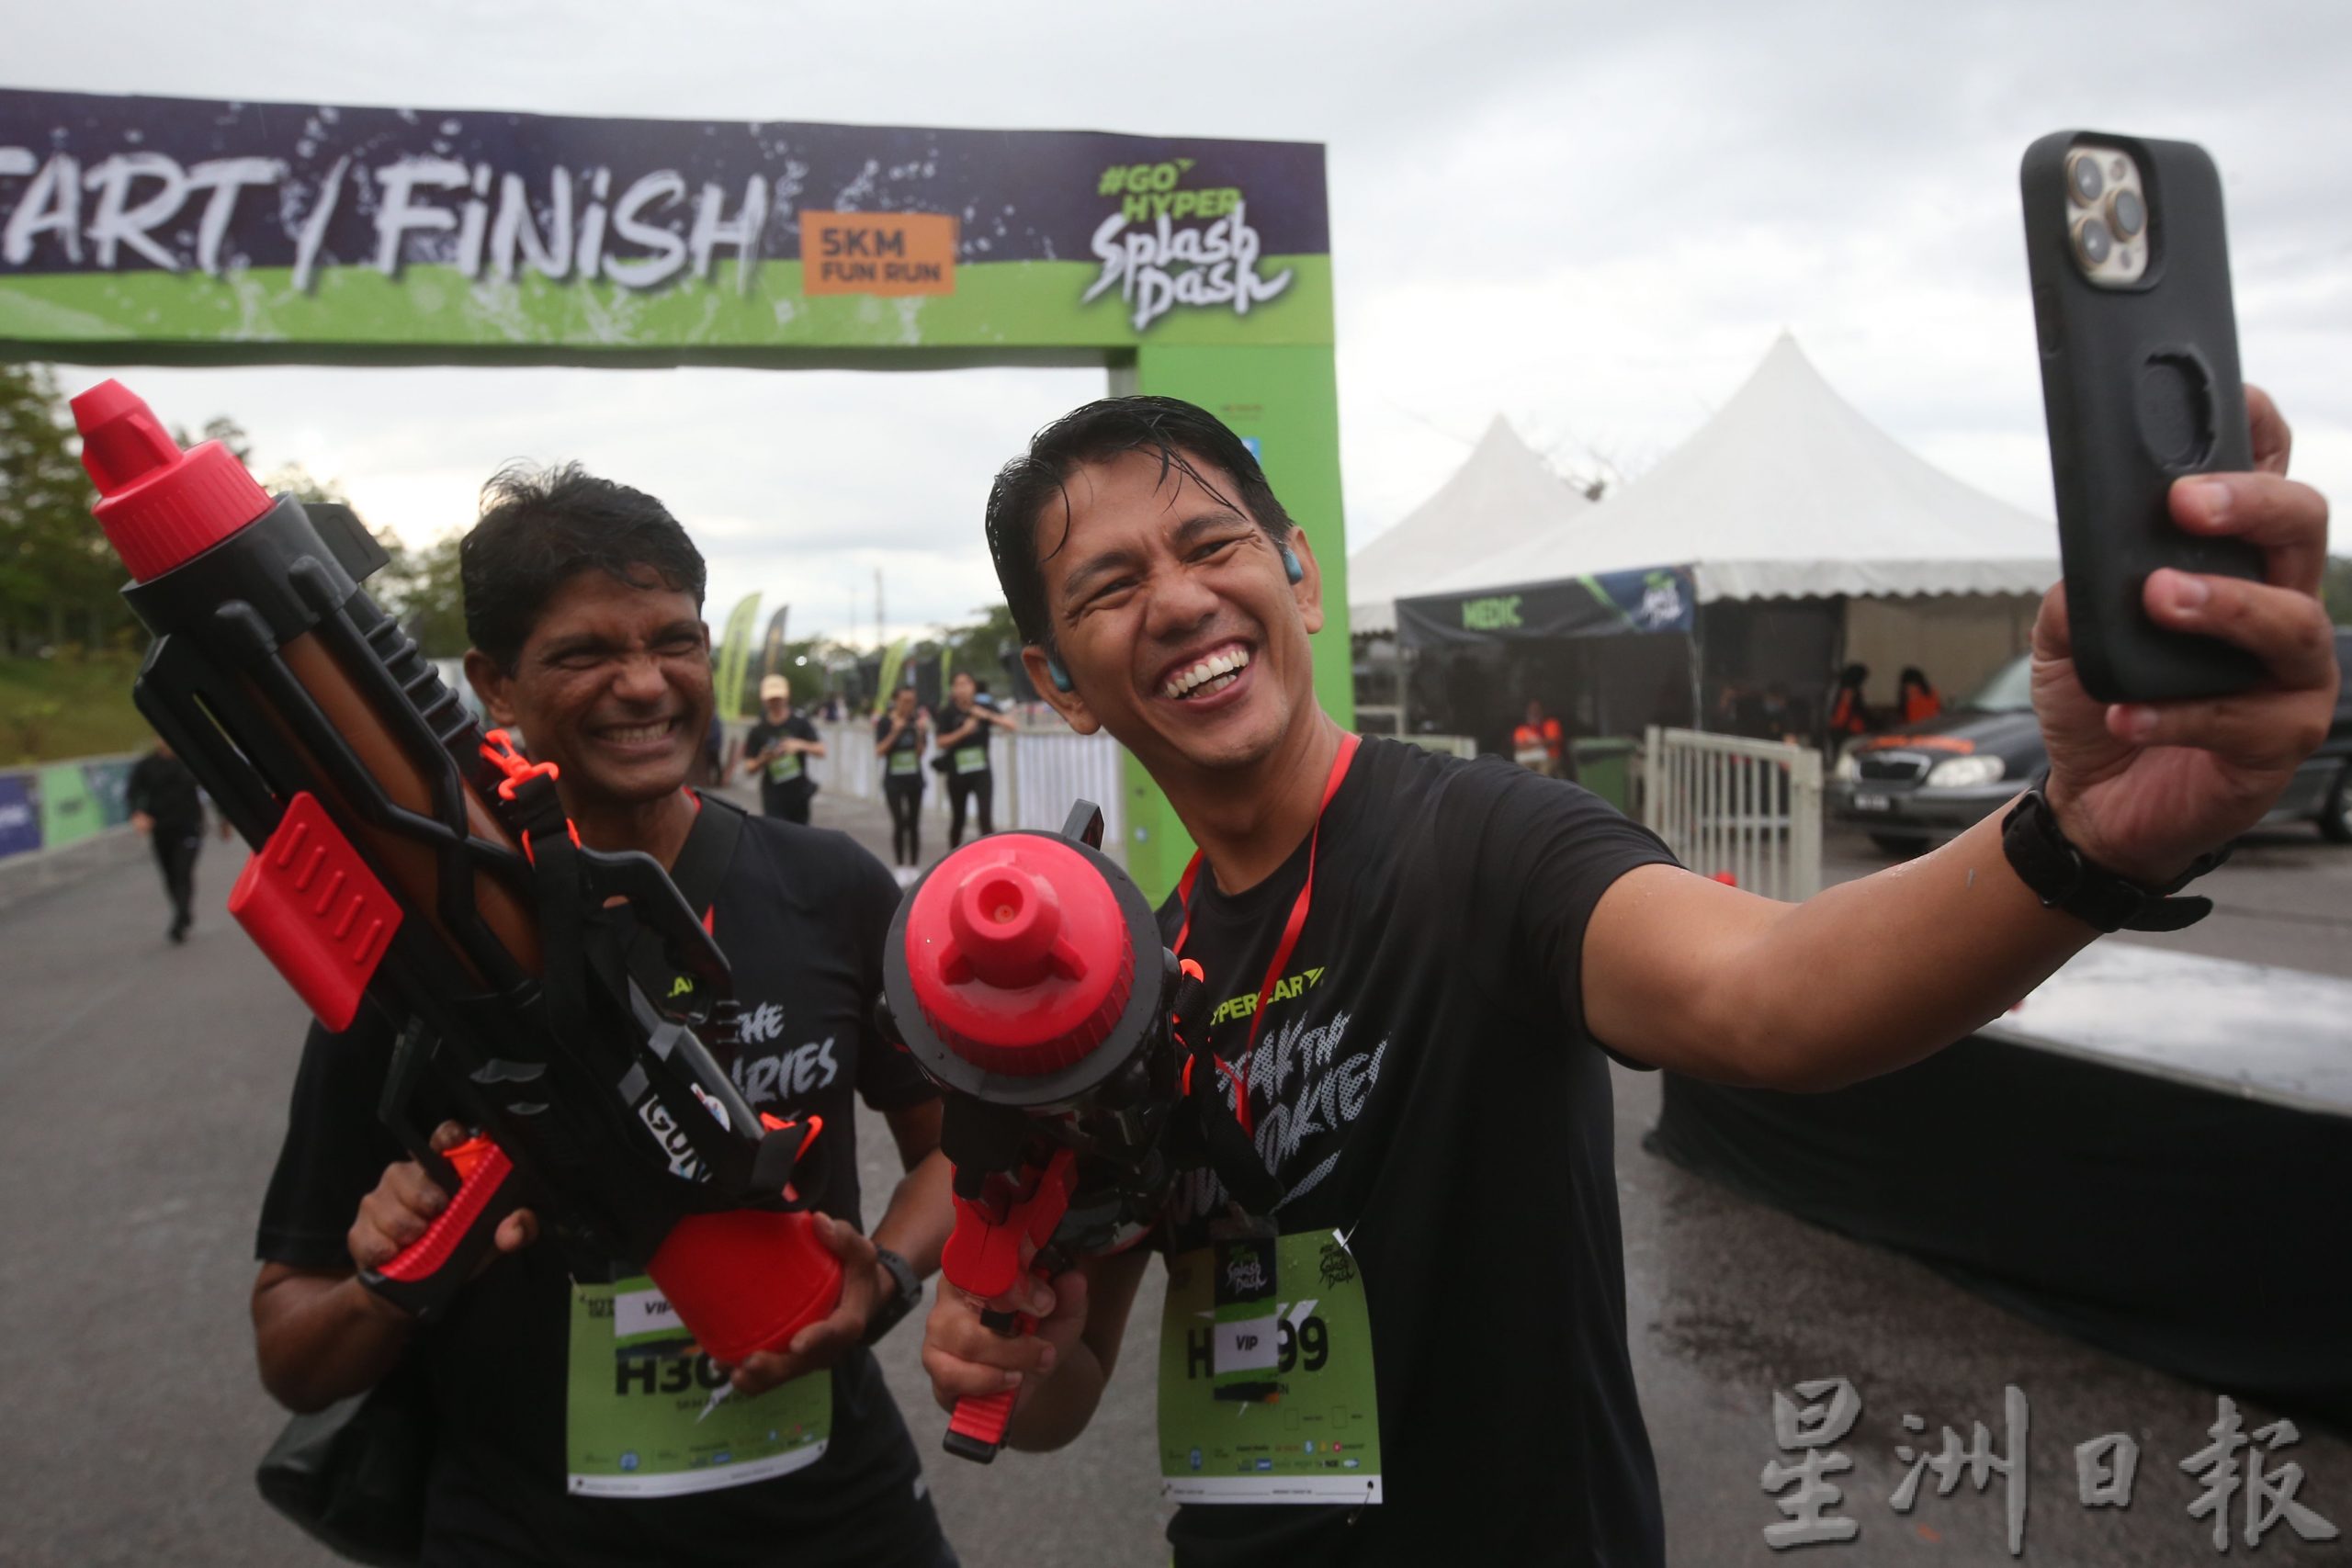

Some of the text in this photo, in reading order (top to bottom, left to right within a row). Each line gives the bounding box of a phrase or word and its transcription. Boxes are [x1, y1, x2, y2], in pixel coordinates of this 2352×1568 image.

[1097, 162, 1180, 197] #GO
[1122, 186, 1243, 222] HYPER
[821, 227, 905, 257] 5KM
[1080, 199, 1260, 304] Splash
[820, 261, 941, 283] FUN RUN
[1129, 260, 1293, 332] Dash
[1463, 595, 1523, 630] MEDIC
[1236, 1335, 1258, 1351] VIP
